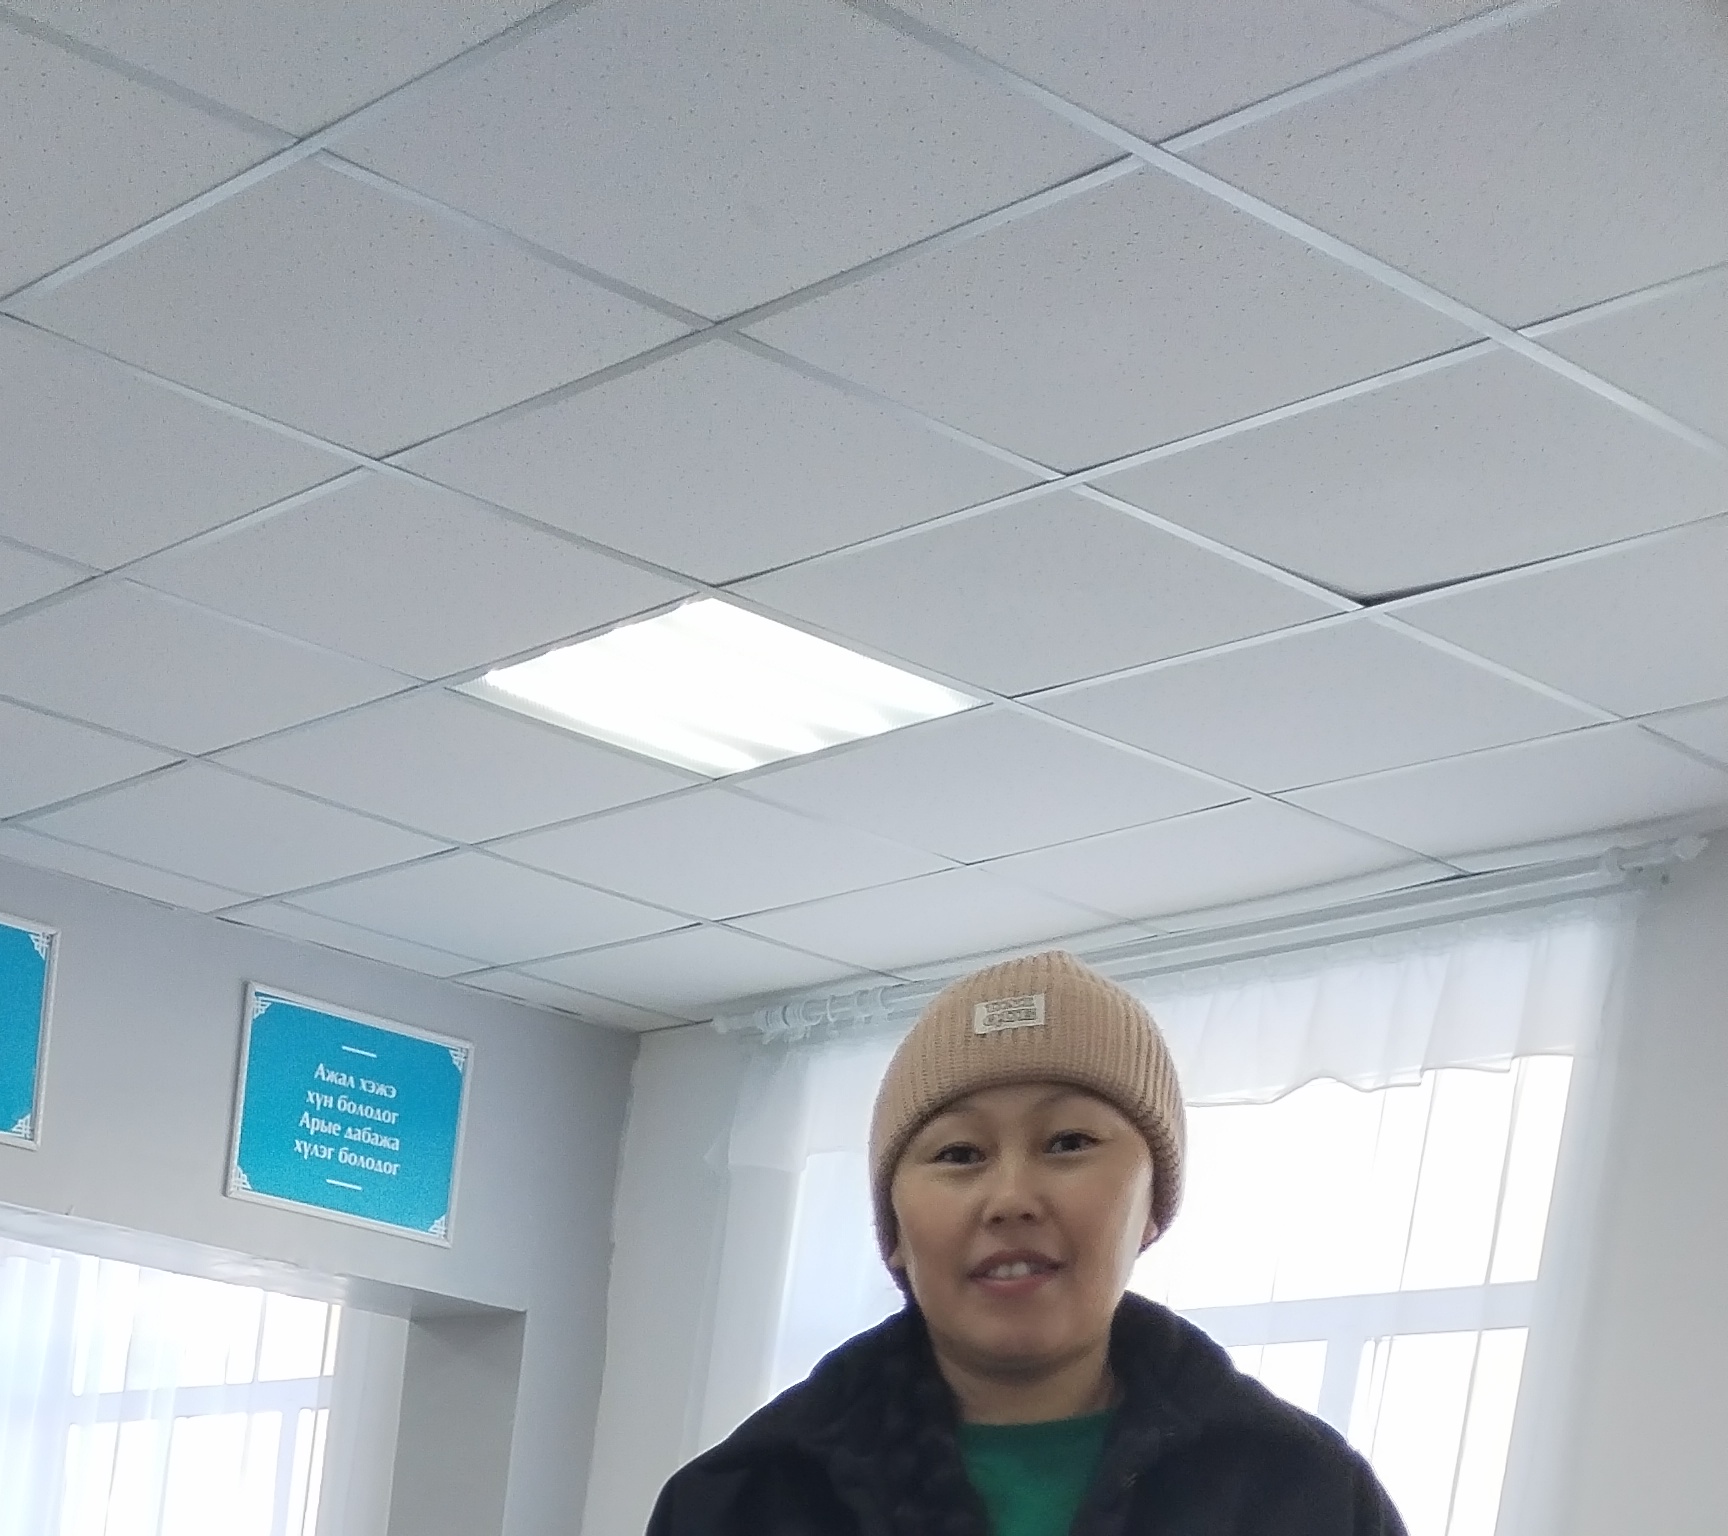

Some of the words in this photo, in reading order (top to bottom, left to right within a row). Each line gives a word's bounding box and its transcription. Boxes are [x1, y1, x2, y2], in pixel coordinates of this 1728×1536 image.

[314, 1063, 355, 1089] Ажал
[359, 1078, 397, 1098] хэжэ
[337, 1095, 399, 1125] болодог
[298, 1111, 341, 1136] Арые
[344, 1127, 400, 1151] дабажа
[338, 1147, 400, 1176] болодог
